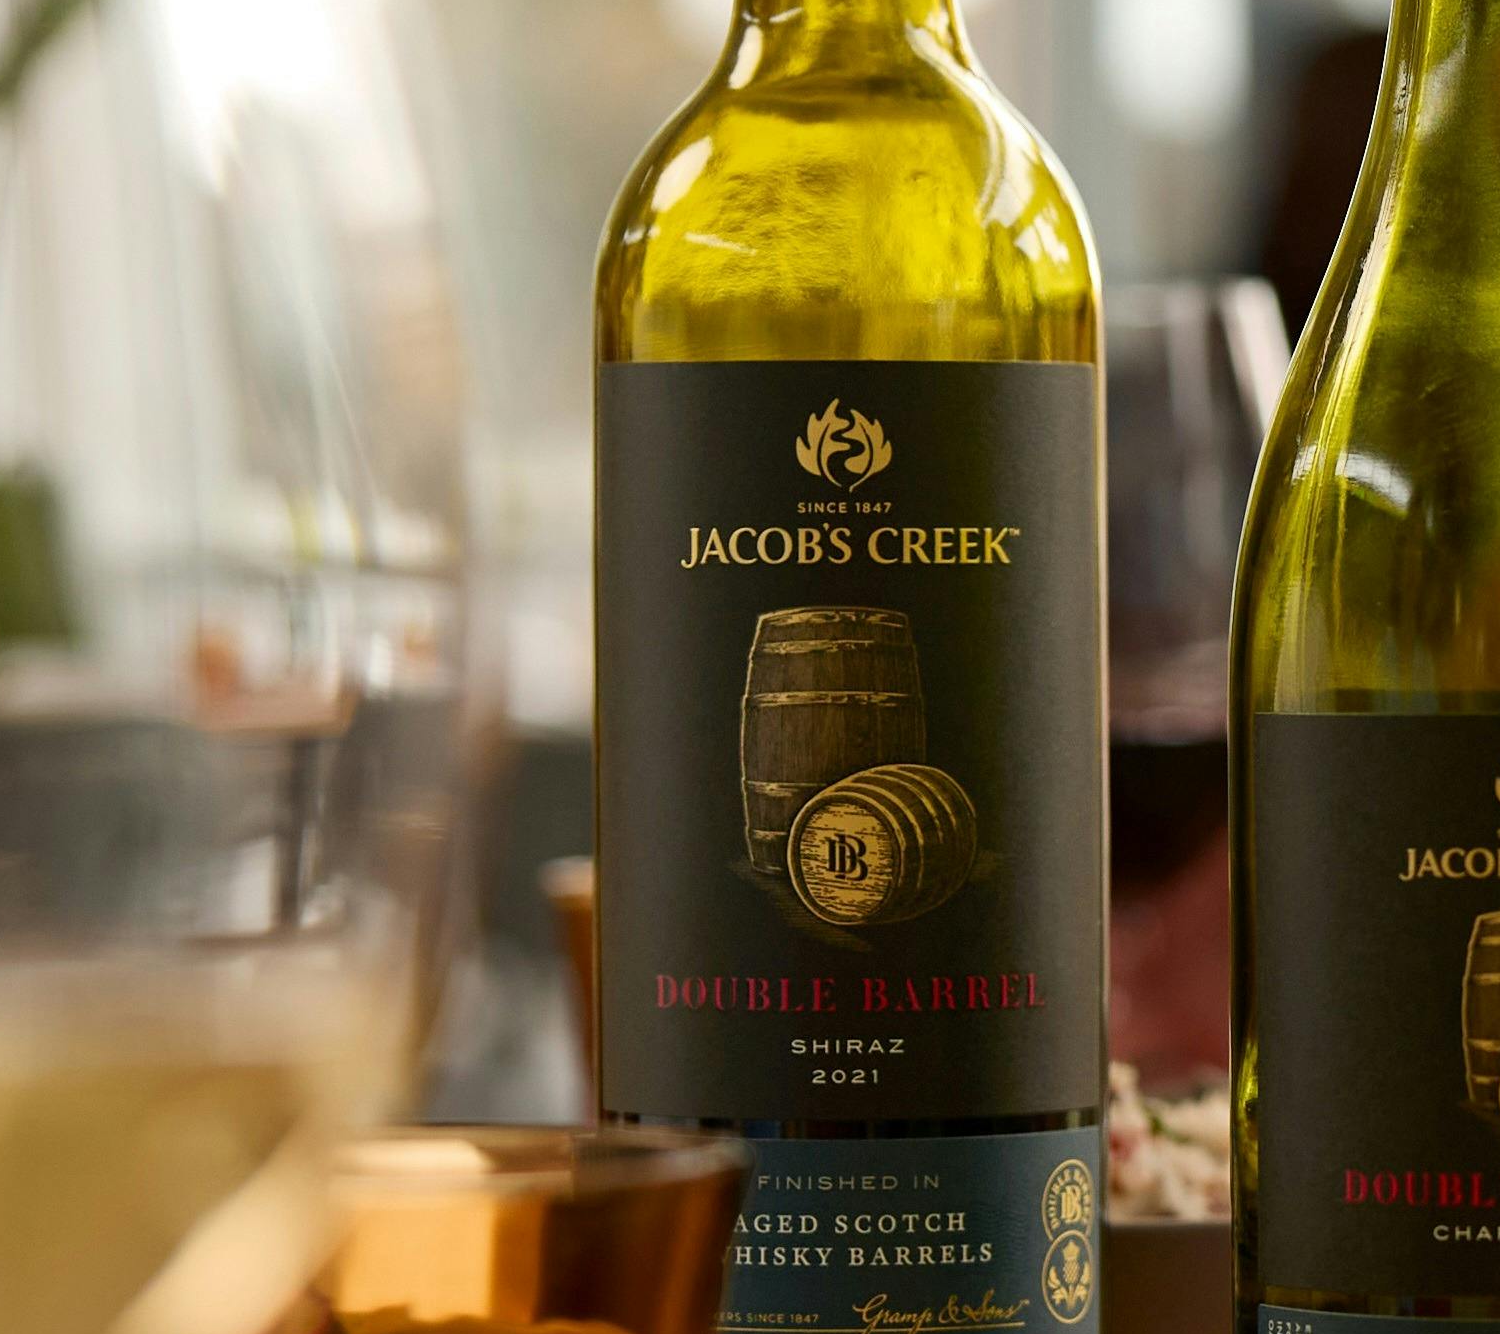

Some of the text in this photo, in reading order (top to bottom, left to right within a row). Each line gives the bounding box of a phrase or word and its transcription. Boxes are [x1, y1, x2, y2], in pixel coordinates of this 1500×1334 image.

[797, 502, 892, 514] SINCE 1847
[680, 522, 852, 569] JACOB'S
[654, 972, 1046, 1012] DOUBLE BARREL
[790, 1038, 905, 1055] SHIRAZ
[811, 1068, 879, 1084] 2021
[756, 1174, 940, 1191] FINISHED IN
[733, 1211, 967, 1235] AGED SCOTCH
[726, 1242, 994, 1267] HISKY BARRELS
[746, 1312, 786, 1323] SINCE
[790, 1312, 820, 1324] 1847
